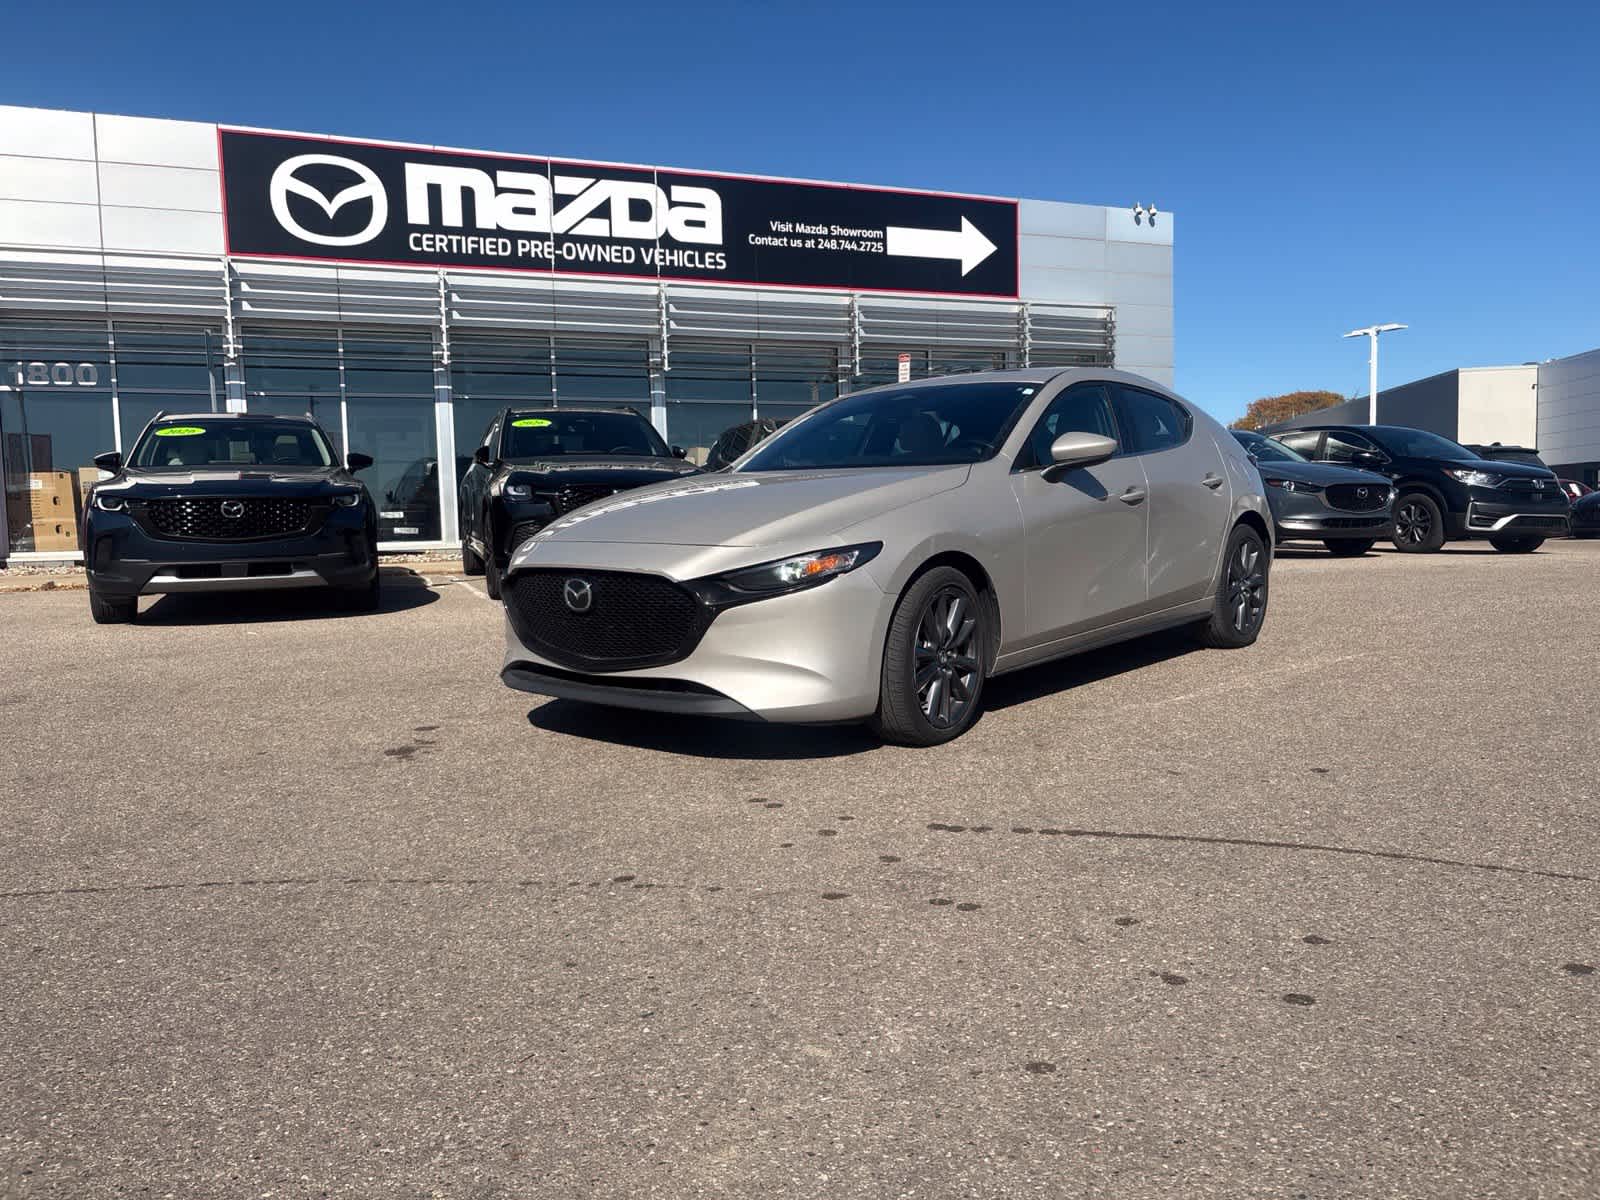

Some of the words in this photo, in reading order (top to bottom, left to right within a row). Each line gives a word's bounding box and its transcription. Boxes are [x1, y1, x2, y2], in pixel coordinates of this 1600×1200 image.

[770, 220, 793, 233] Visit
[795, 223, 829, 235] Mazda
[830, 225, 884, 239] Showroom
[409, 233, 512, 256] CERTIFIED
[517, 240, 635, 263] PRE-OWNED
[640, 247, 726, 270] VEHICLES
[748, 233, 788, 247] Contact
[790, 238, 803, 248] us
[804, 238, 816, 249] at
[817, 238, 884, 253] 248.744.2725
[8, 362, 98, 386] 1800
